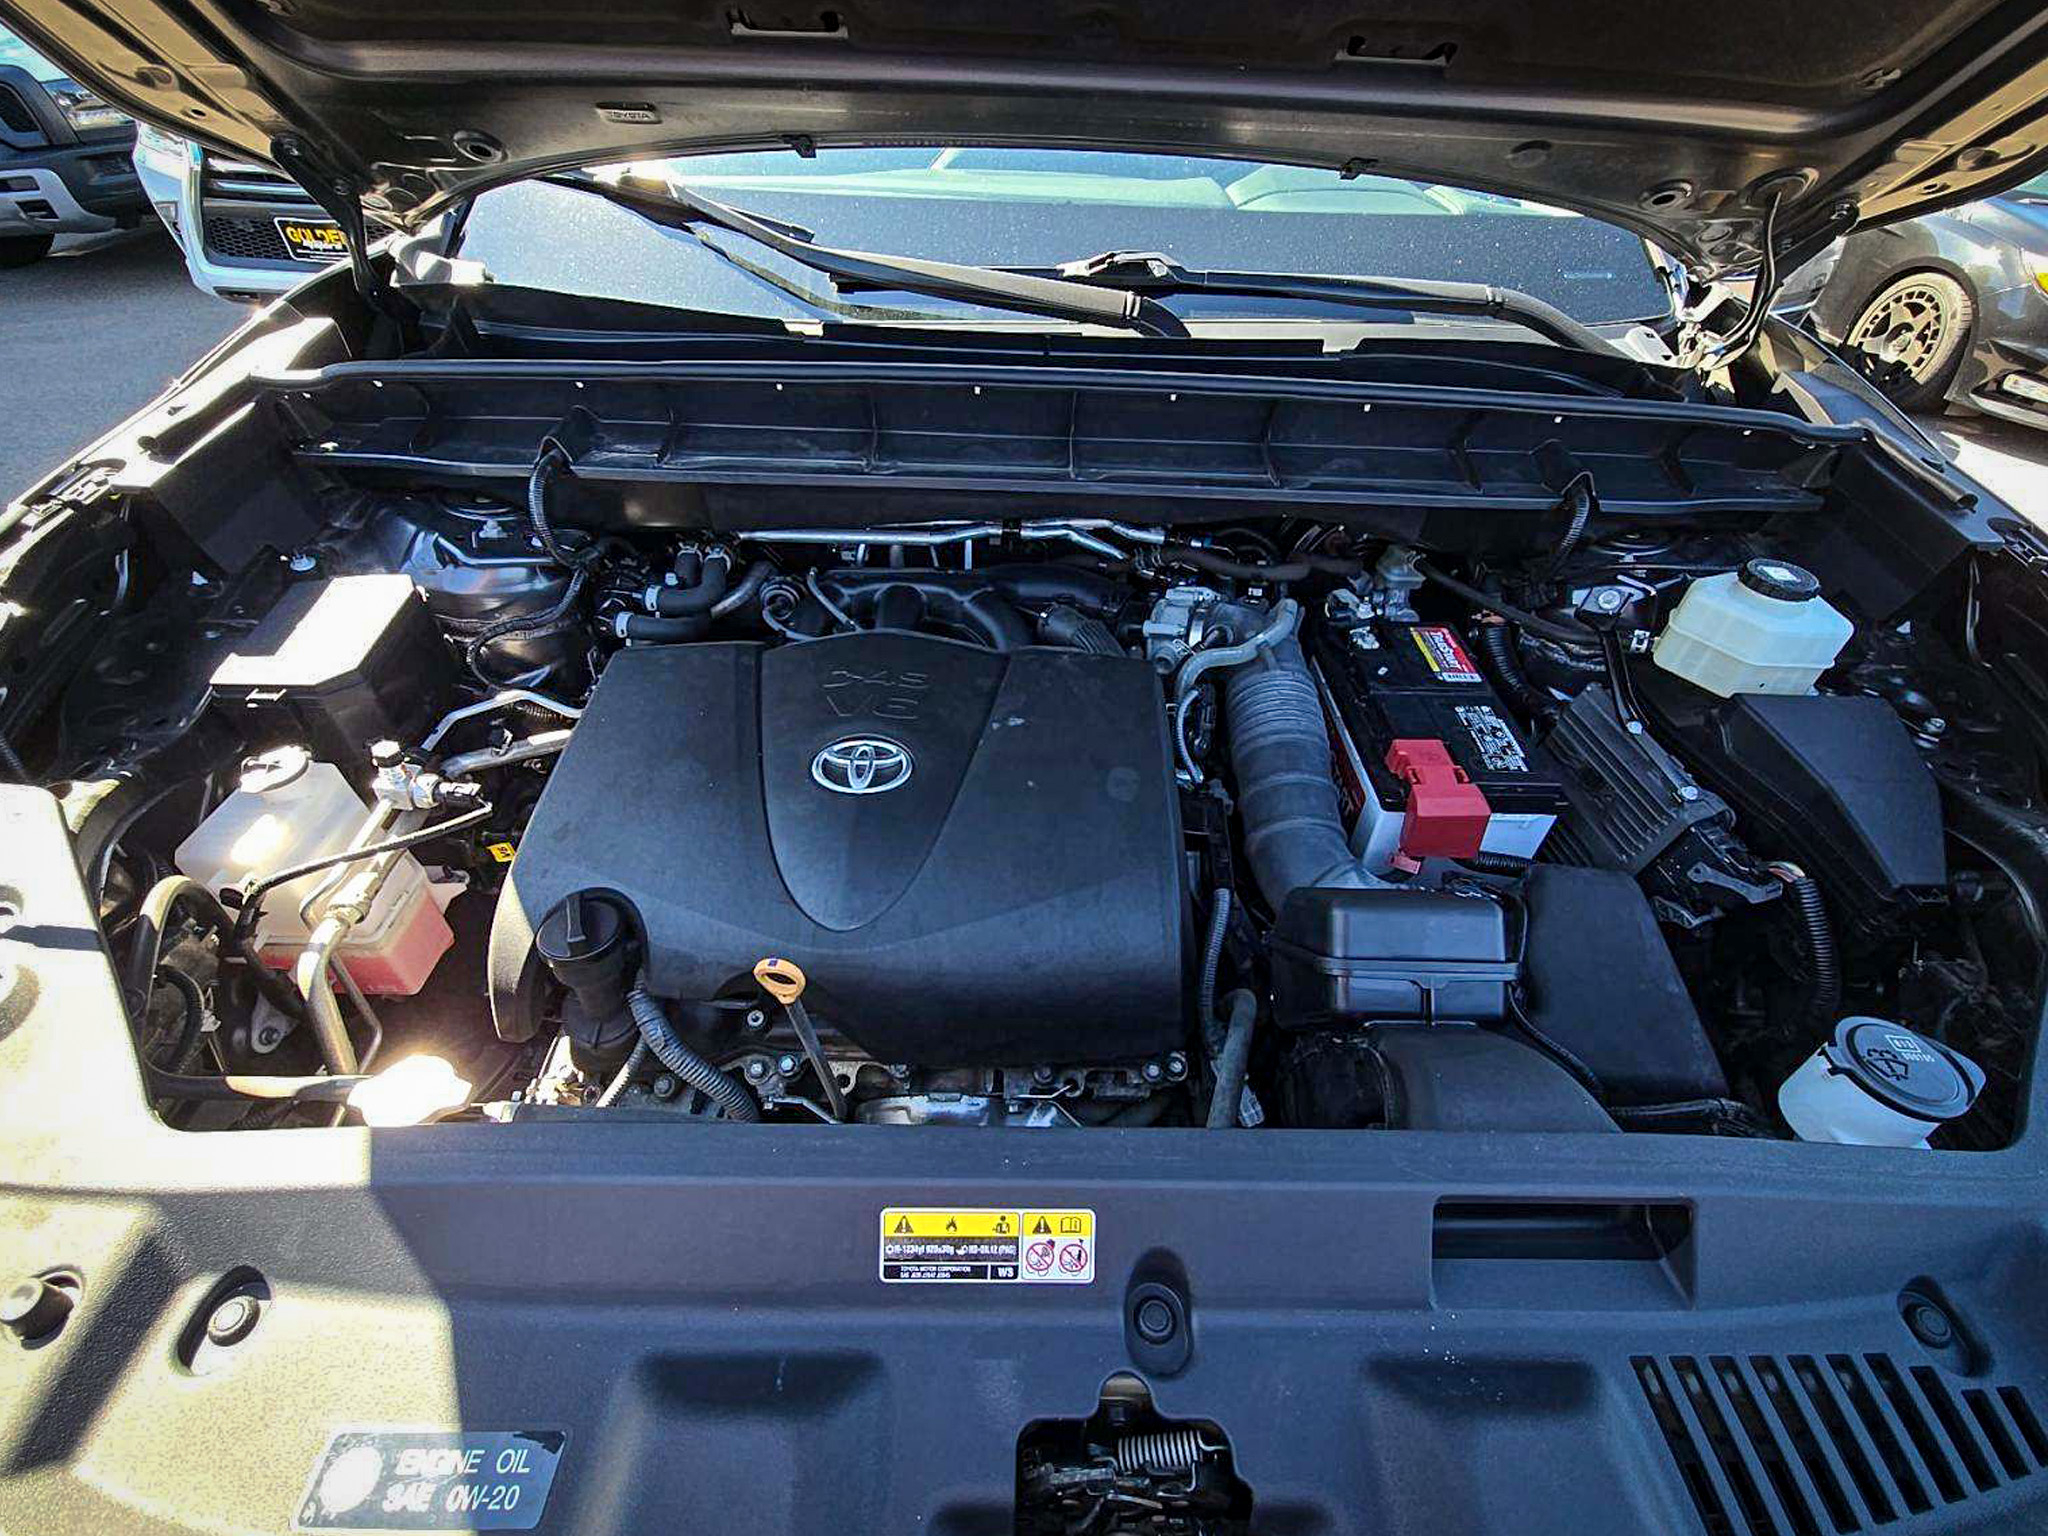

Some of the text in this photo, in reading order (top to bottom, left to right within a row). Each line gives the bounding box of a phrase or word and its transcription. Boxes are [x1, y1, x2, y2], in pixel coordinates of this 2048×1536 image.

[394, 1448, 532, 1476] ENGINE OIL
[382, 1482, 521, 1513] SAE 0W-20
